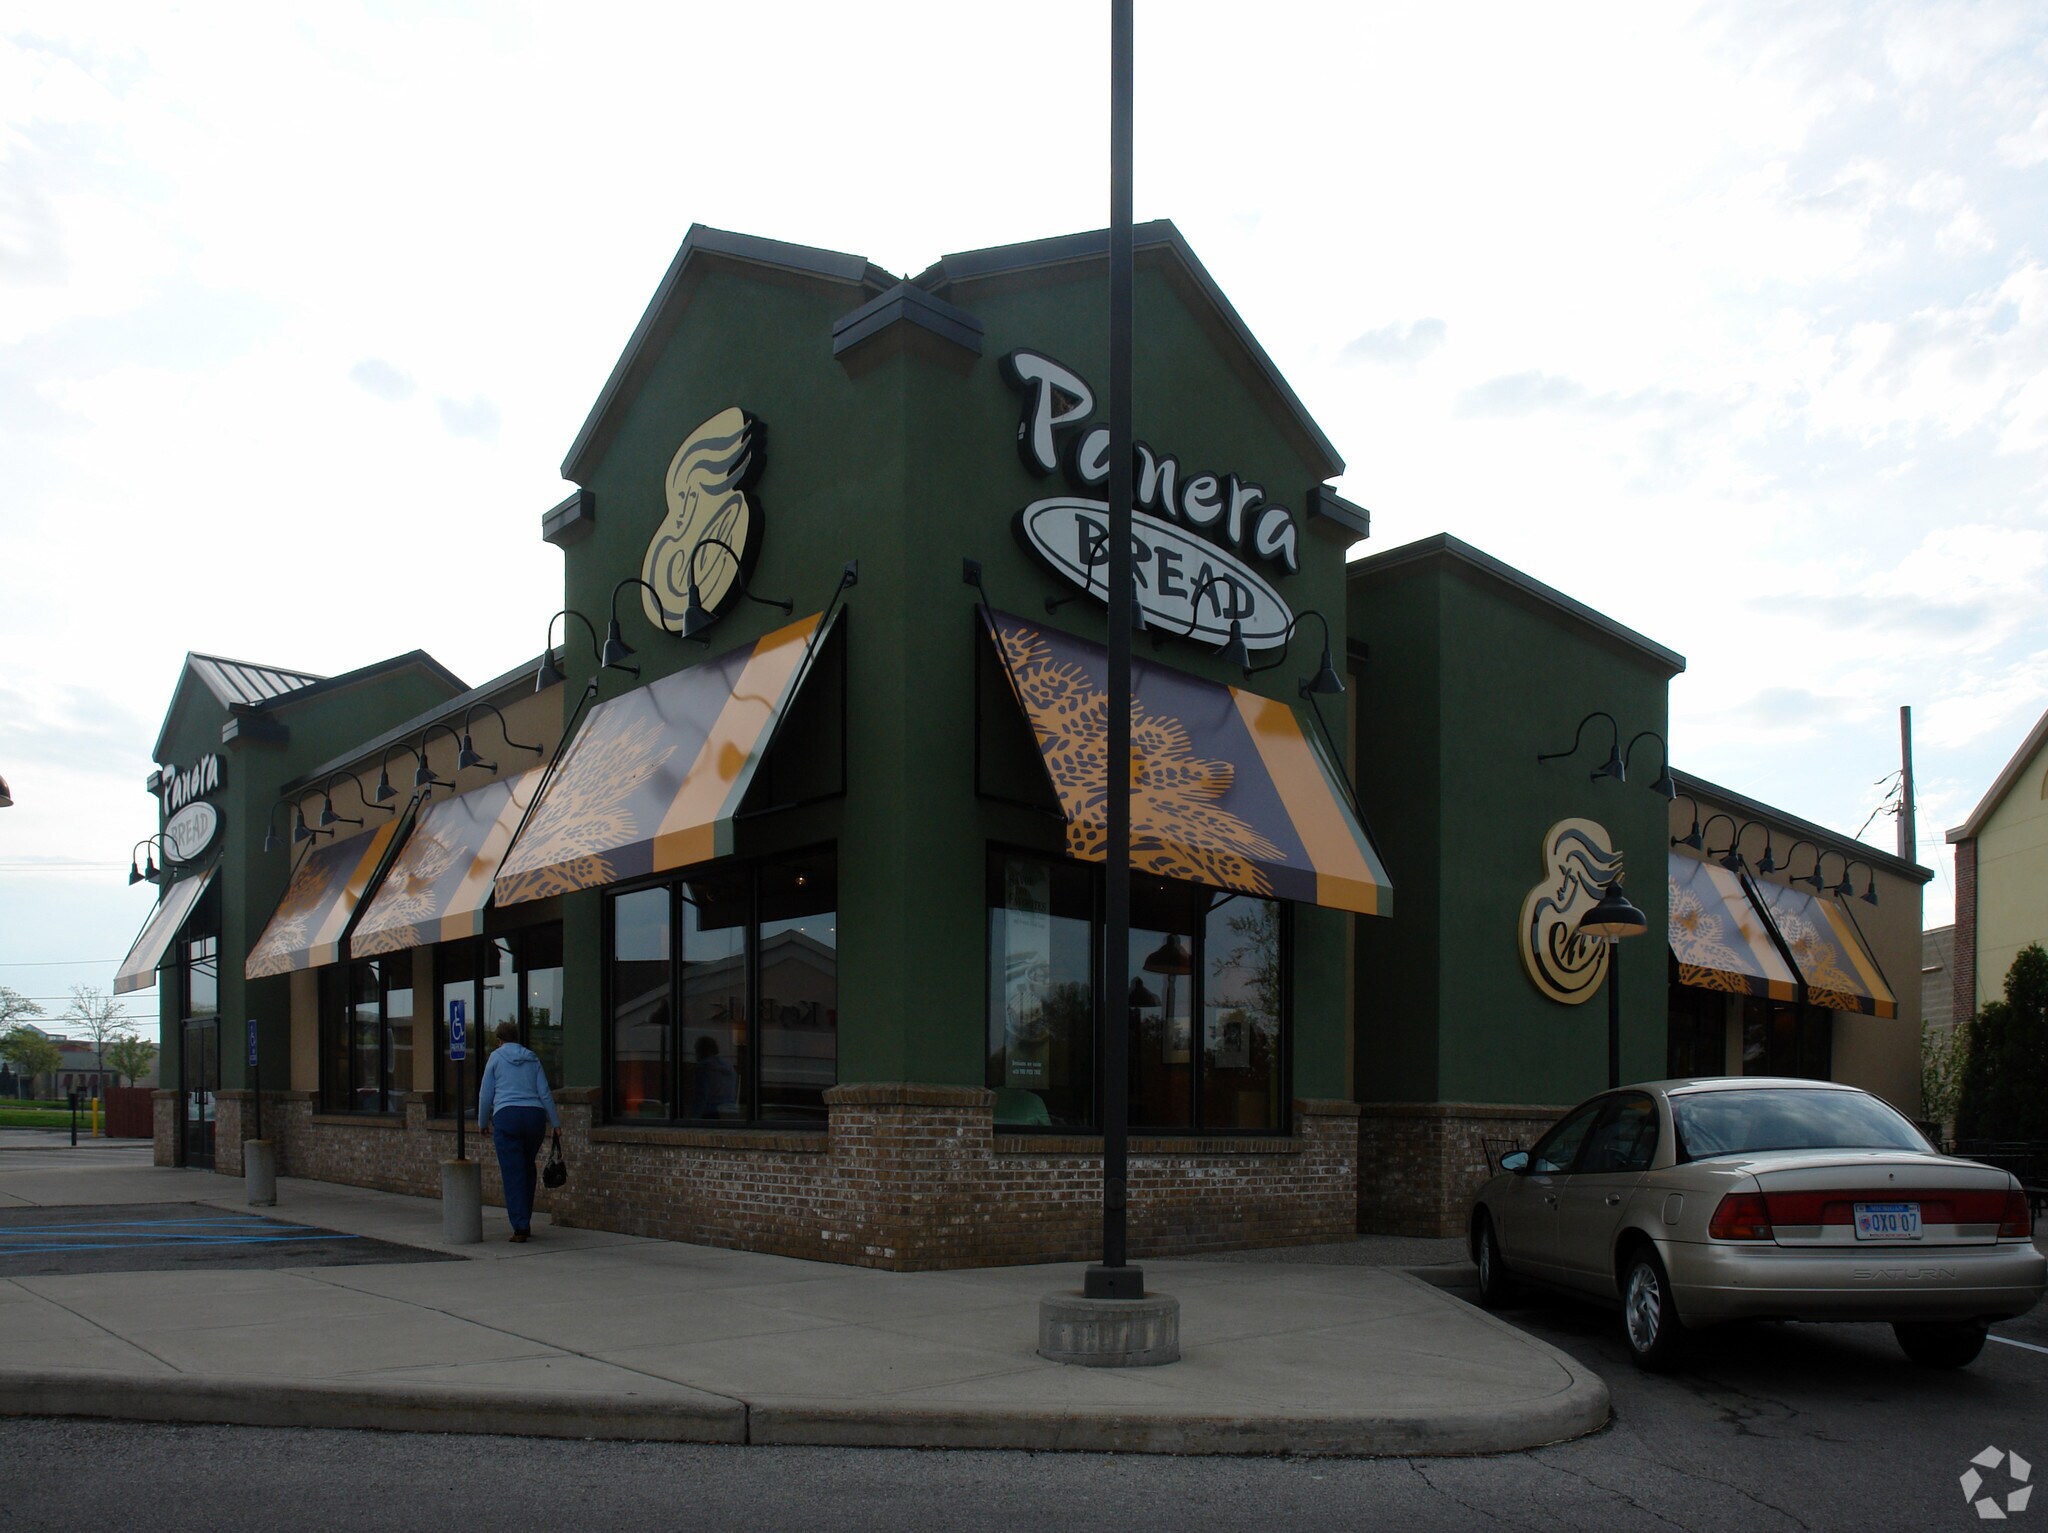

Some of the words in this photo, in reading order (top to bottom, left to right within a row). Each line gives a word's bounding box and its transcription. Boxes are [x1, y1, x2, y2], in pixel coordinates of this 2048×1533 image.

[162, 753, 219, 816] Panera
[171, 813, 209, 849] BREAD
[1854, 1268, 1956, 1280] SATURN
